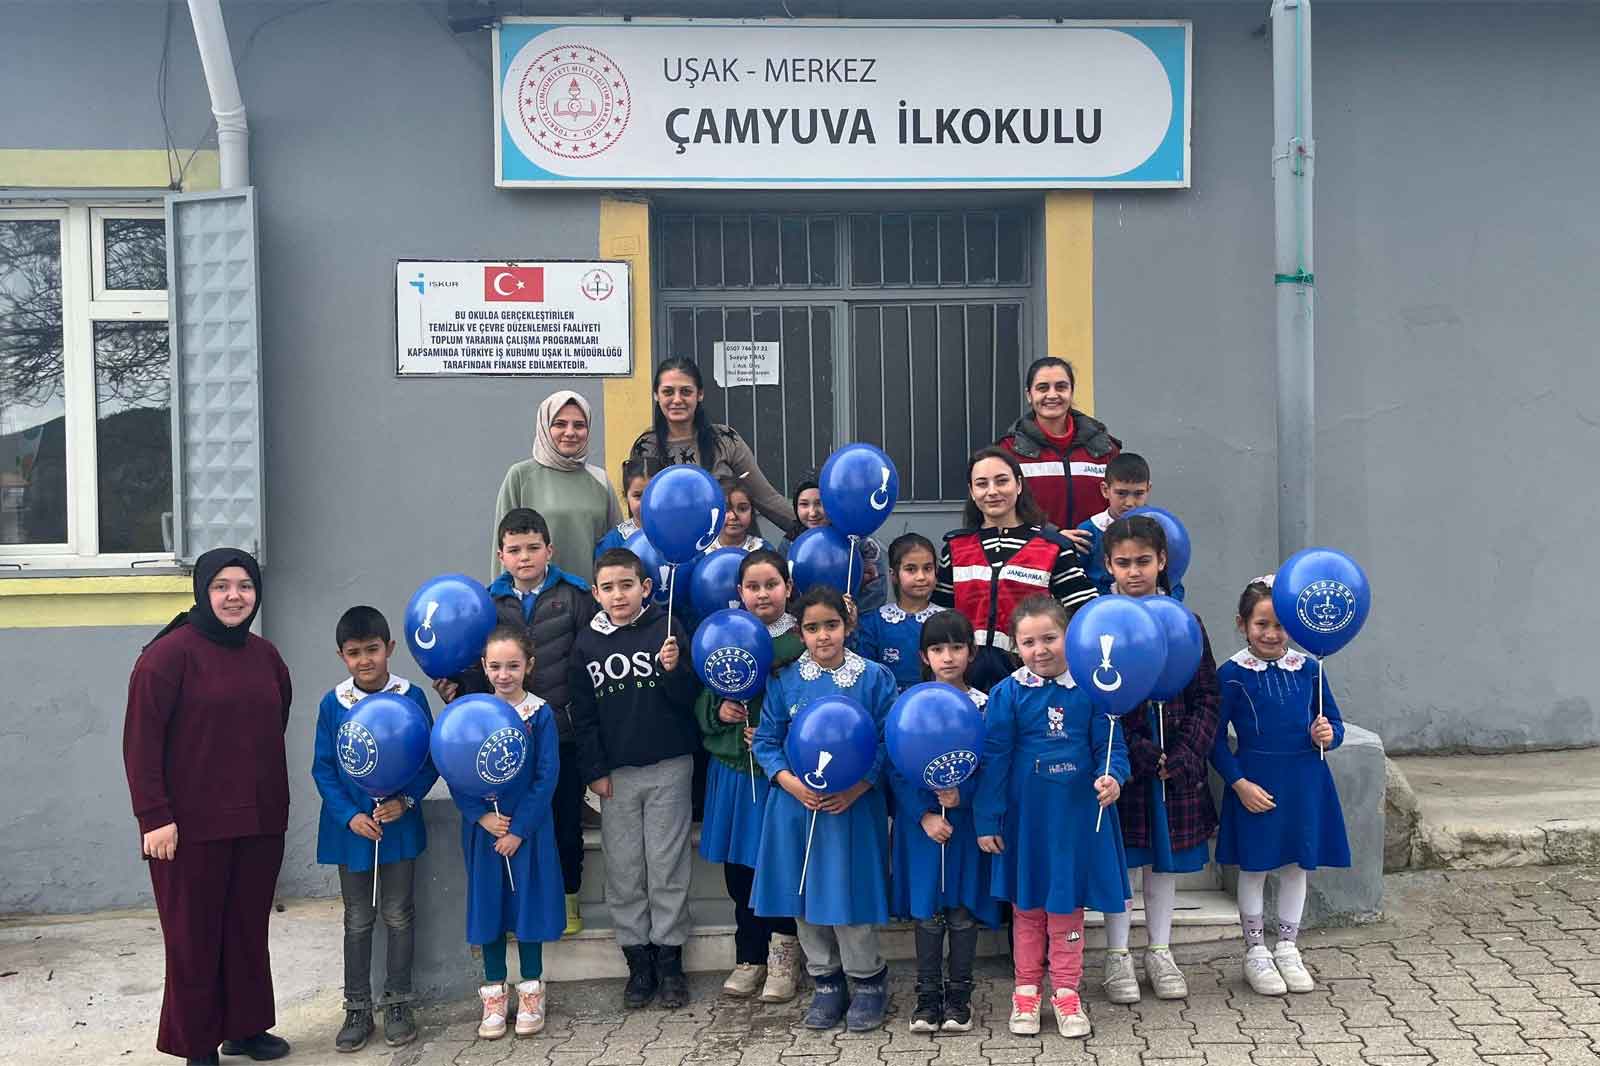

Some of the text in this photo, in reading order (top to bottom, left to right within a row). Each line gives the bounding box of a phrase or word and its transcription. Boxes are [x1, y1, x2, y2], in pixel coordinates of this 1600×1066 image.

[664, 57, 740, 89] UŞAK
[764, 57, 877, 83] MERKEZ
[665, 99, 1102, 155] ÇAMYUVA İLKOKULU
[455, 309, 575, 322] BU OKULDA GERÇEKLEŞTİRİLEN
[429, 322, 465, 332] TEMİZLİK
[467, 323, 477, 332] VE
[479, 323, 505, 334] ÇEVRE
[507, 321, 561, 333] DÜZENLEMESİ
[431, 335, 599, 347] TOPLUM YARARINA ÇALIŞMA PROGRAMLARI
[407, 347, 459, 357] KAPSAMINDA
[461, 346, 494, 357] TÜRKİYE
[506, 348, 540, 357] KURUMU
[541, 348, 562, 359] UŞAK
[574, 346, 622, 358] MÜDÜRLÜĞÜ
[443, 360, 492, 369] TARAFINDAN
[1007, 569, 1042, 581] JANDARMA
[1301, 582, 1354, 604] JANDARMA
[706, 649, 754, 674] JANDARMA
[586, 651, 660, 688] BOS
